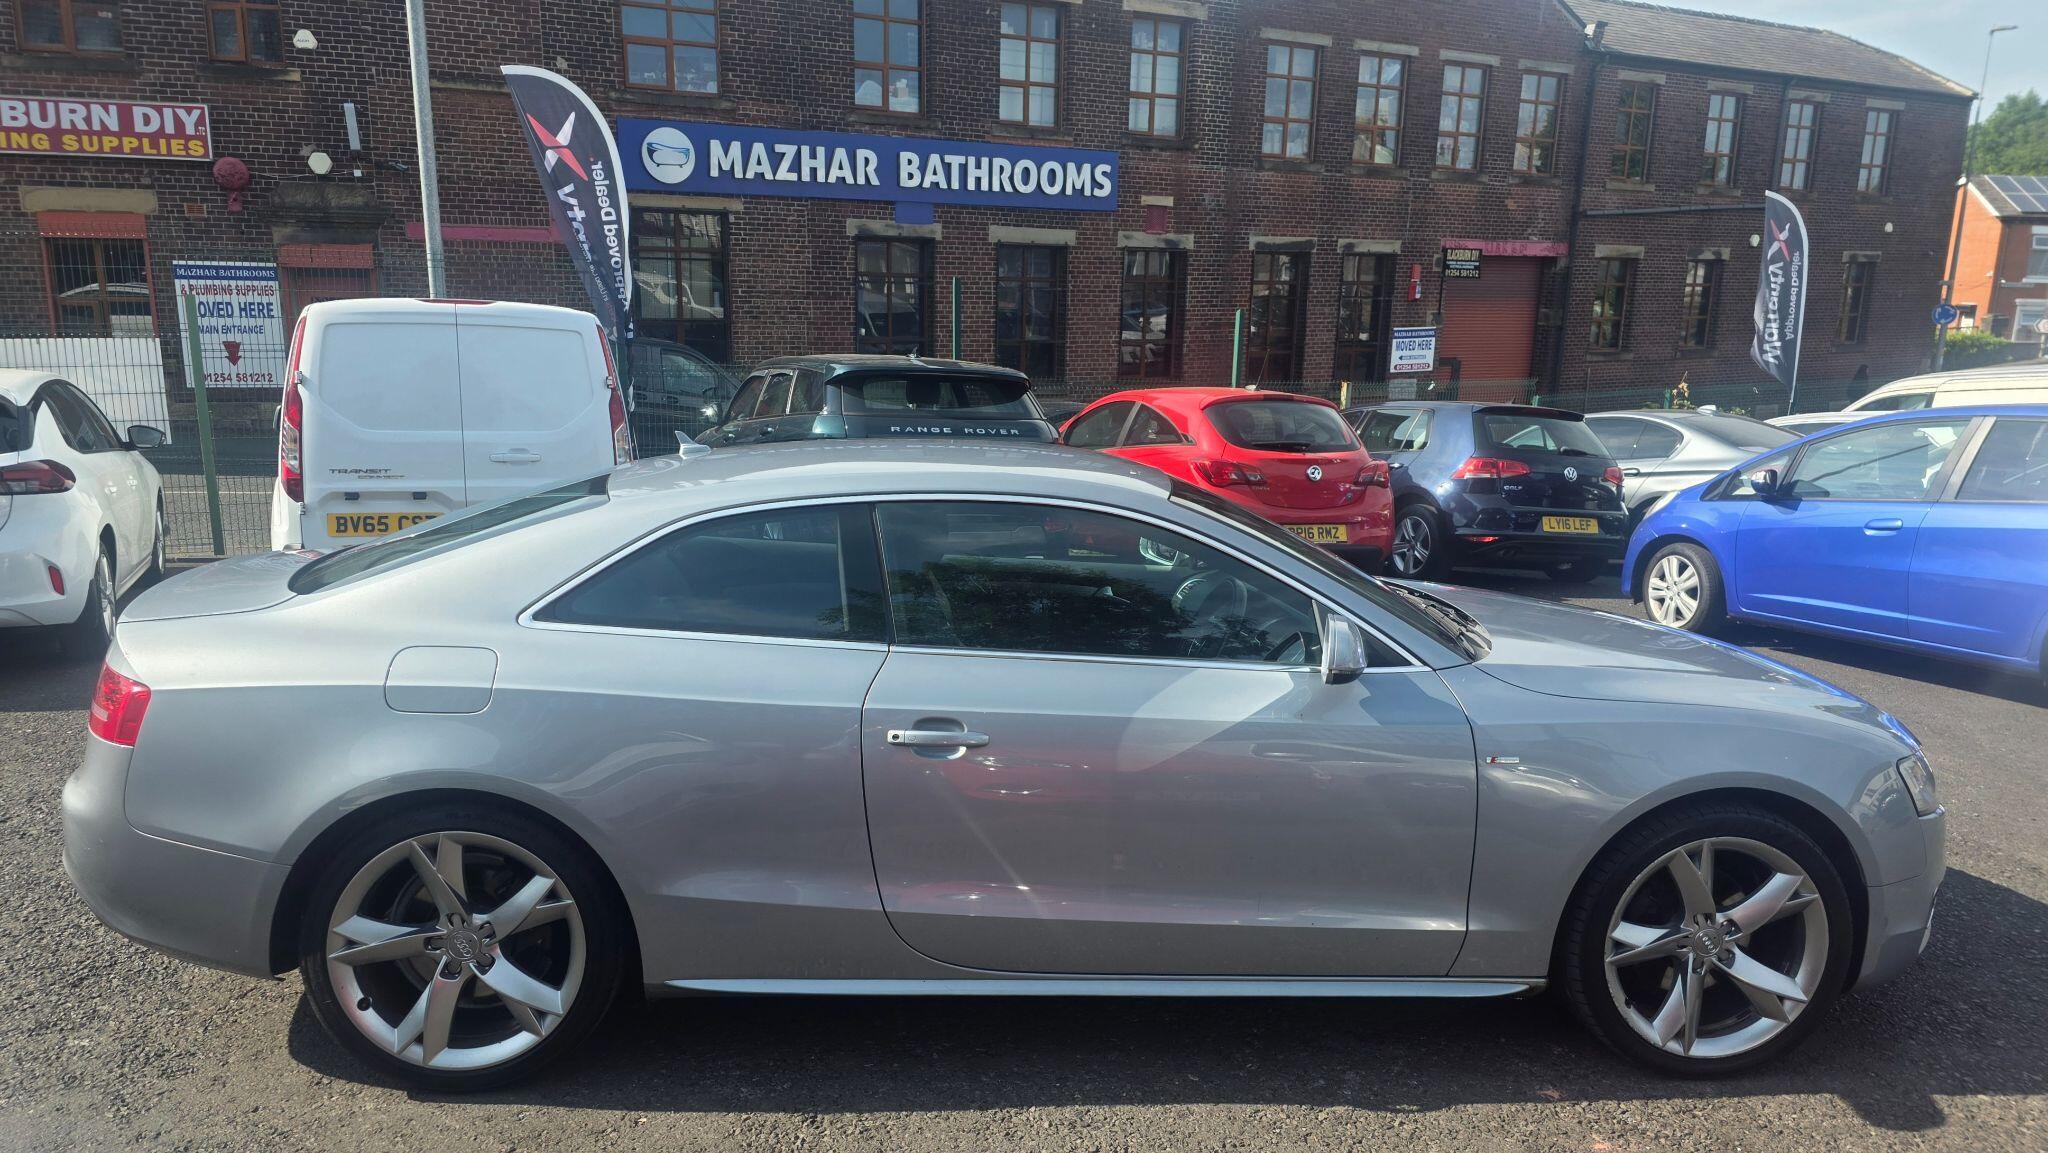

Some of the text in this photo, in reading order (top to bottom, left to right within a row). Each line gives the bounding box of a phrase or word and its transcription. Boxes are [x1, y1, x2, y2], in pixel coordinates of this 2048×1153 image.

[132, 105, 201, 136] DIY
[62, 134, 205, 157] SUPPLIES
[709, 139, 1112, 198] MAZHAR BATHROOMS
[176, 268, 275, 278] MAZHAR BATHROOMS
[181, 284, 275, 297] & PLUMBING SUPPLIES
[197, 301, 275, 319] OVED HERE
[221, 325, 264, 335] ENTRANCE
[1396, 339, 1432, 351] MOVED HERE
[205, 373, 274, 383] 1254 581212
[890, 426, 1020, 435] RANGE ROVER
[335, 515, 389, 534] BV65
[1548, 517, 1592, 532] LY16 LEF
[1317, 526, 1340, 540] RMZ
